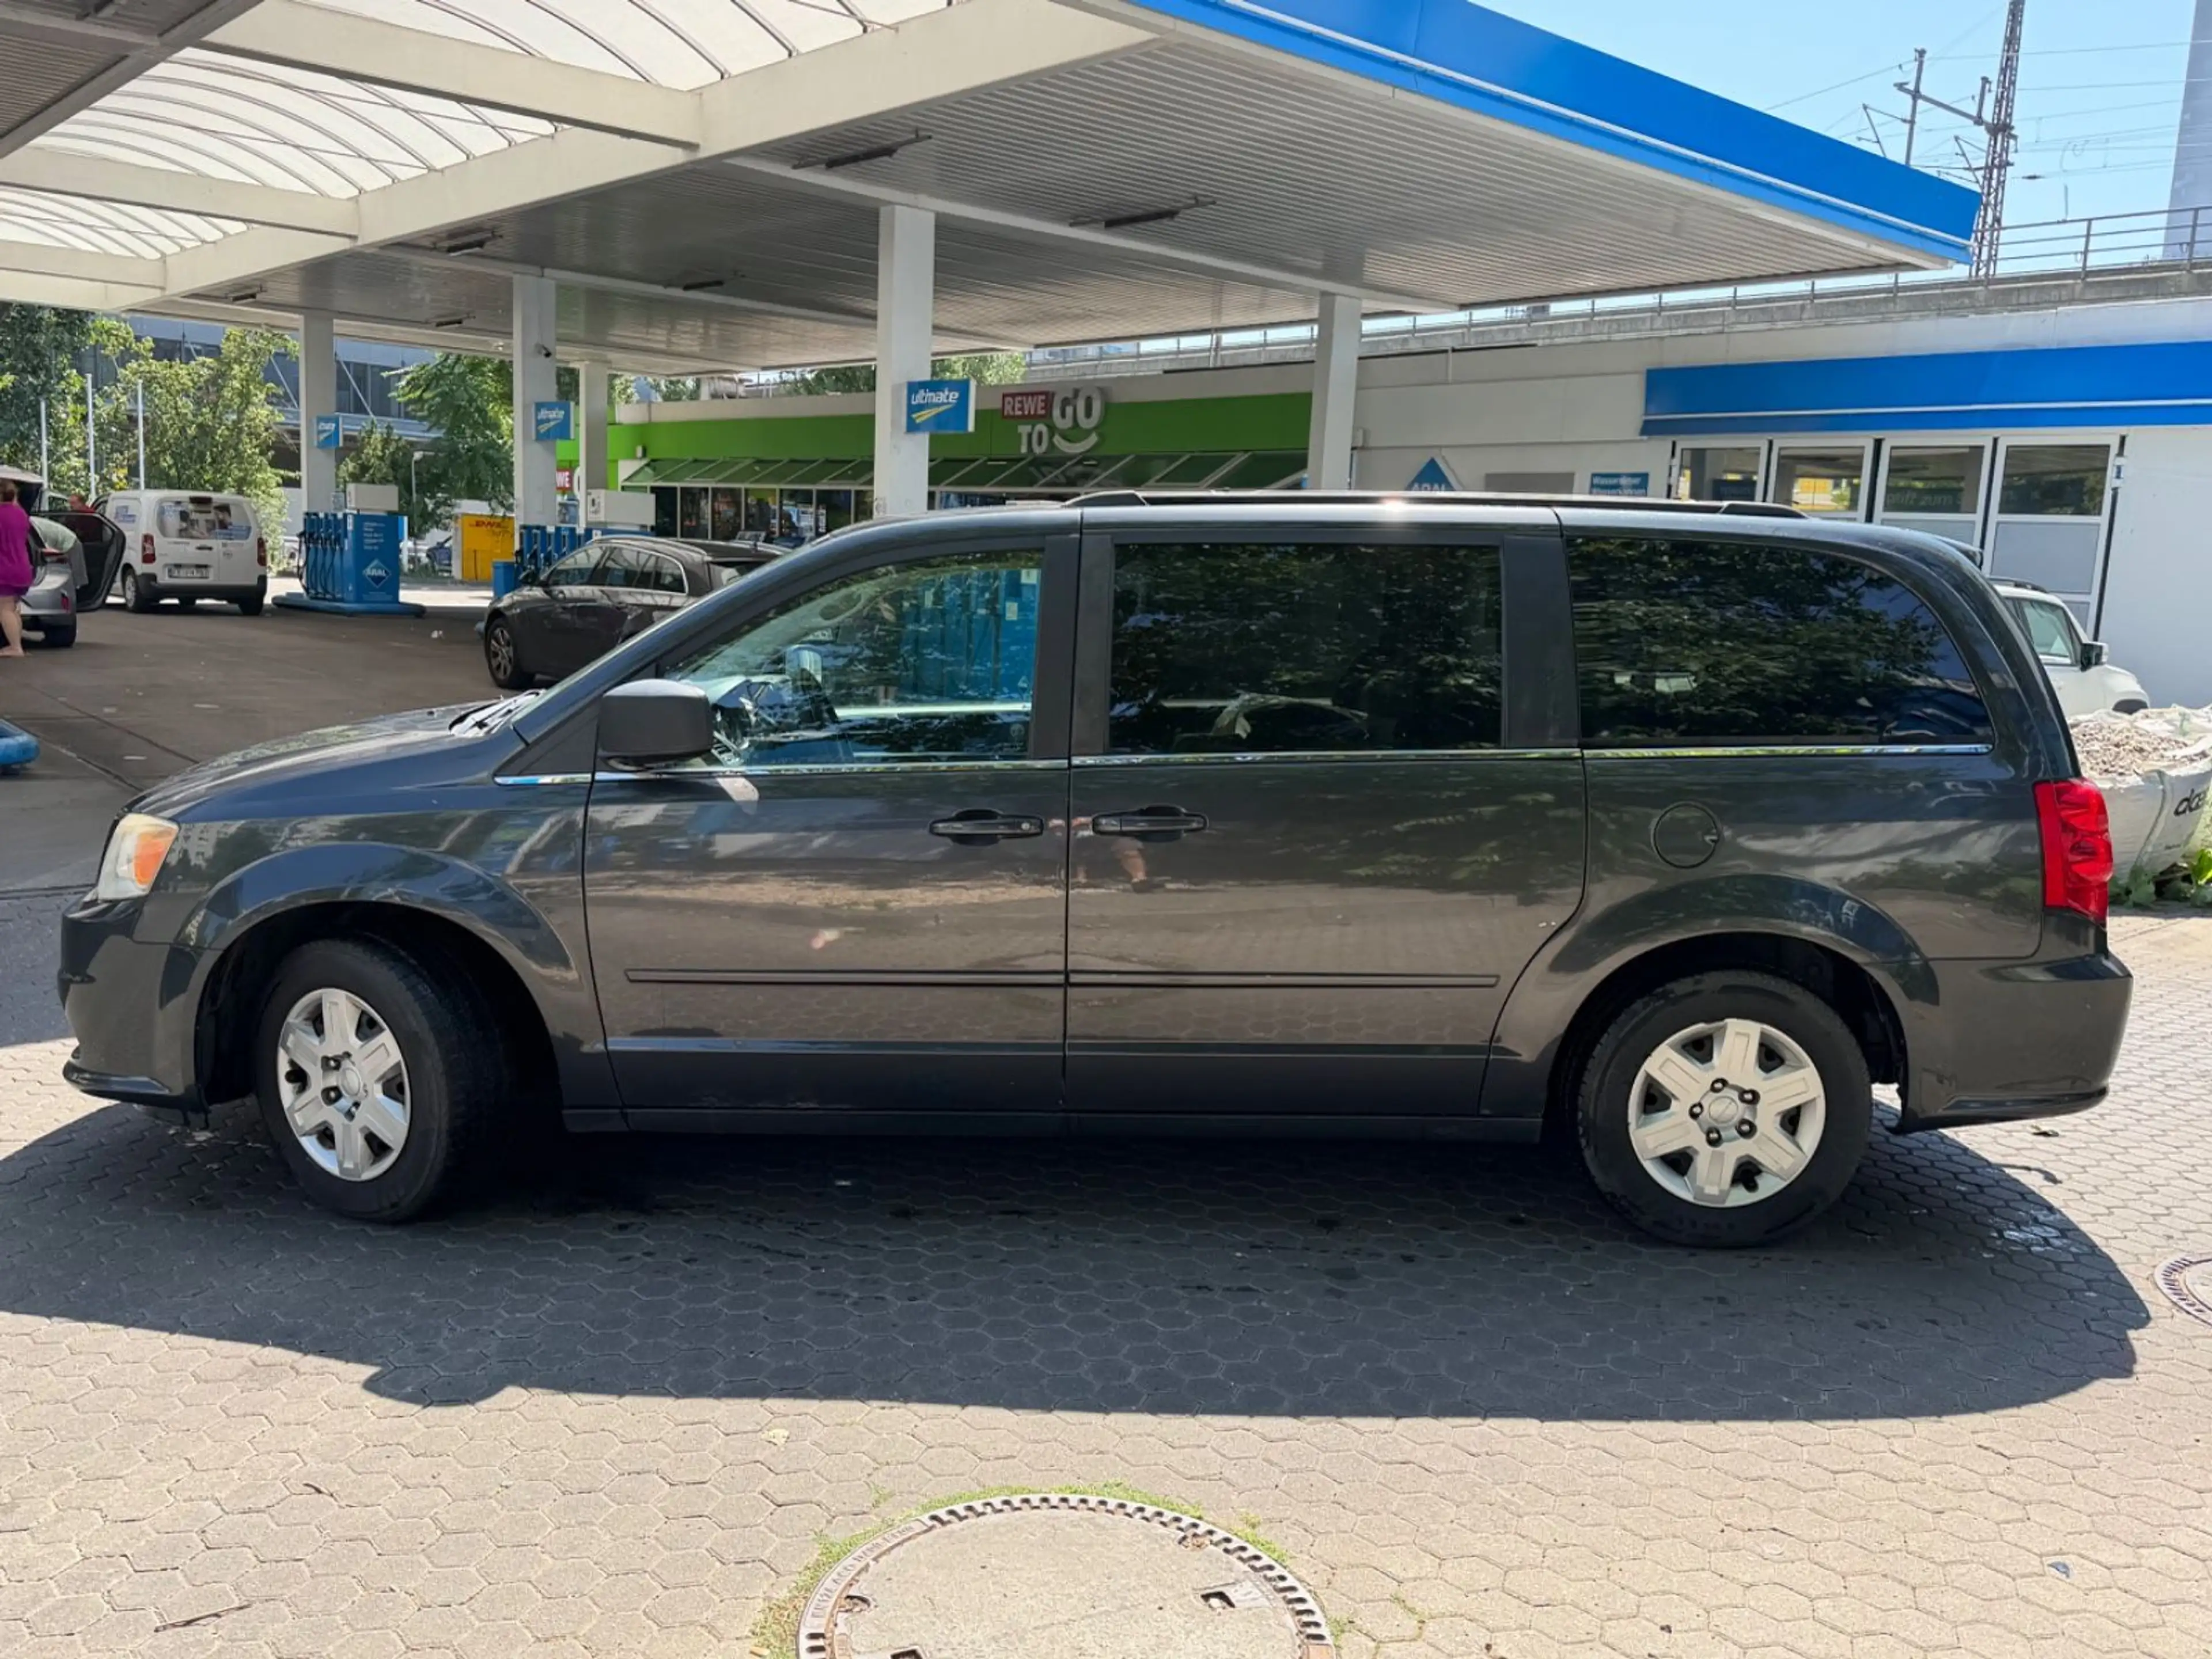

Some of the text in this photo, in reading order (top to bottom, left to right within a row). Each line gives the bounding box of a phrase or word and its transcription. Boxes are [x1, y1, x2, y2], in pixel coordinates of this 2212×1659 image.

[911, 387, 959, 404] ultimate
[1003, 394, 1046, 416] REWE
[1052, 387, 1101, 430] GO
[1017, 423, 1049, 454] TO
